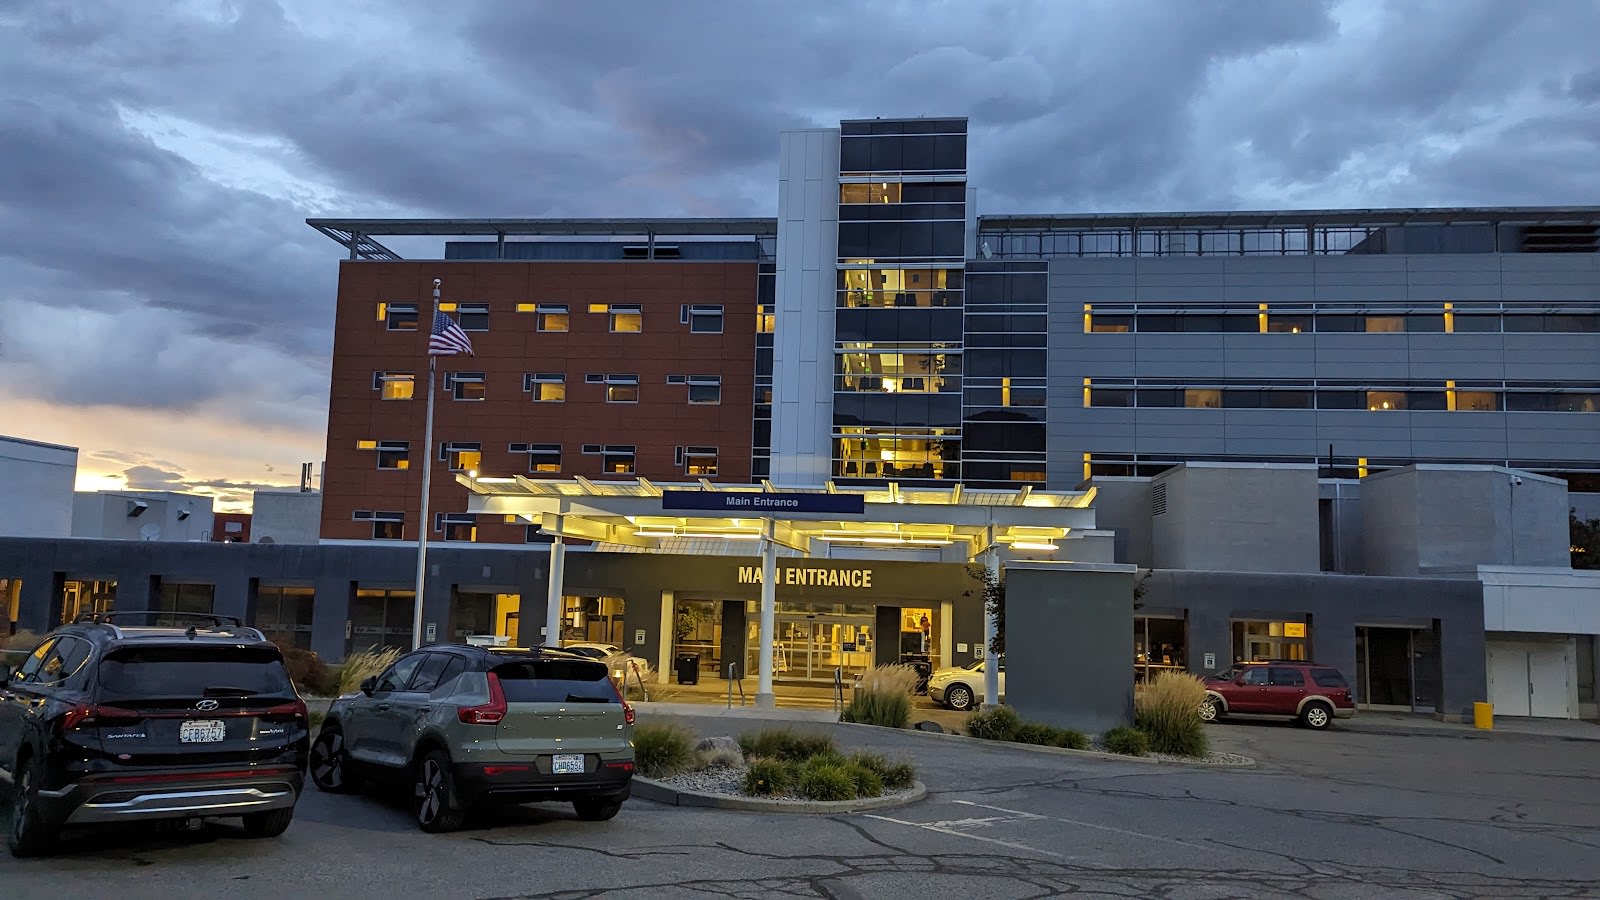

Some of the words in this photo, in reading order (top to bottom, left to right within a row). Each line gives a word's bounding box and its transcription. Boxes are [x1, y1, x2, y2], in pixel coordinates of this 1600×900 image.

[726, 497, 750, 506] Main
[753, 497, 799, 507] Entrance
[738, 566, 780, 584] MAN
[785, 568, 872, 588] ENTRANCE
